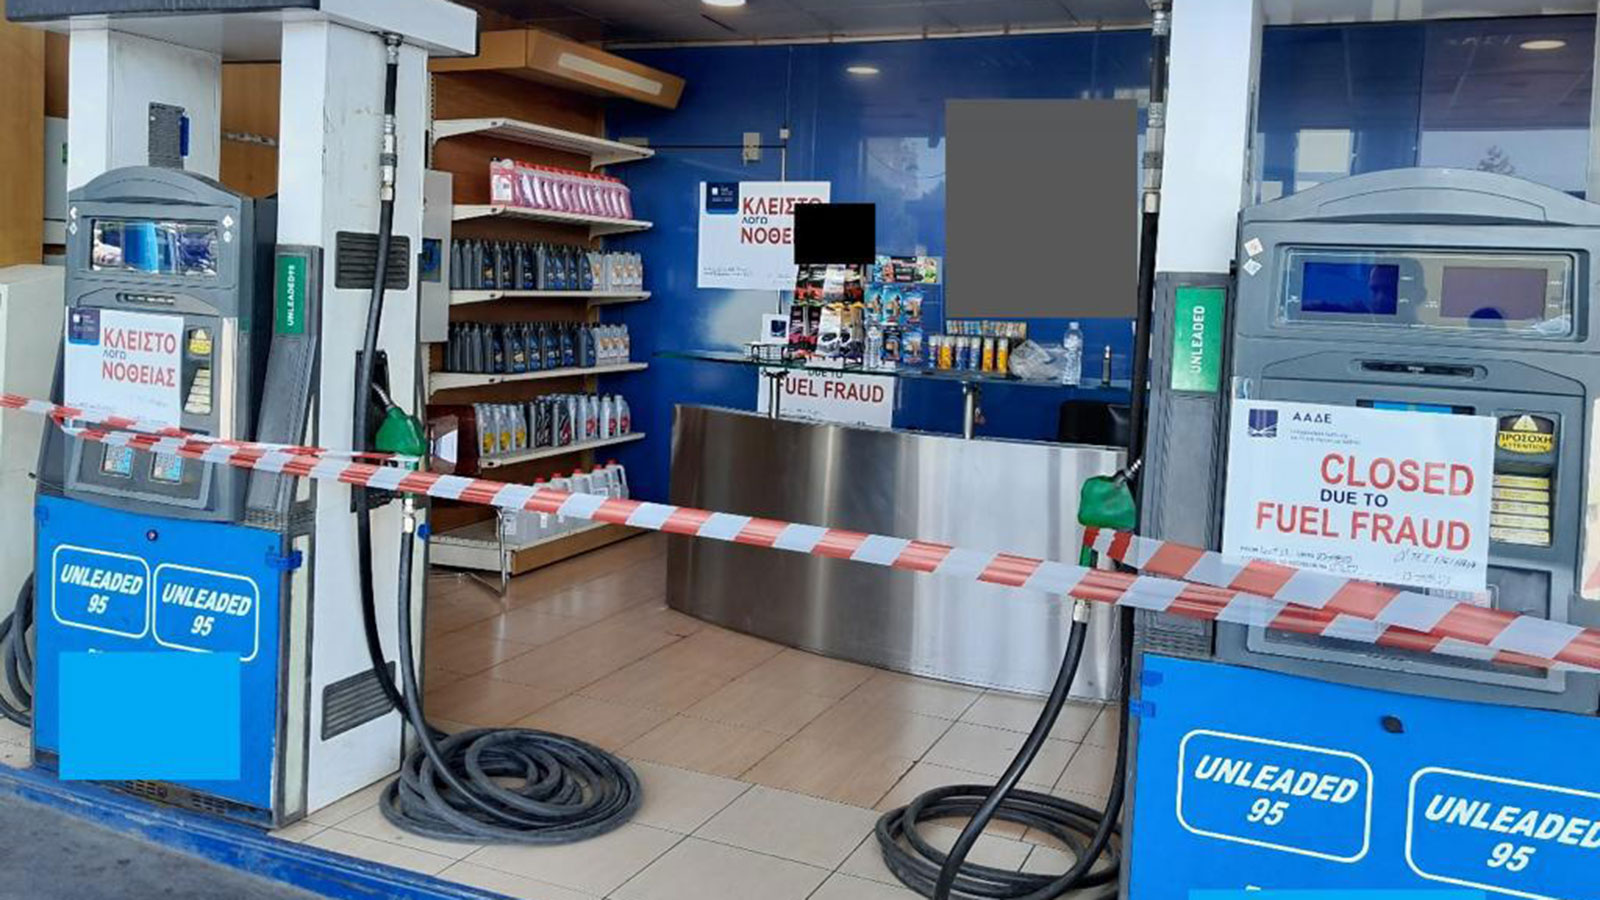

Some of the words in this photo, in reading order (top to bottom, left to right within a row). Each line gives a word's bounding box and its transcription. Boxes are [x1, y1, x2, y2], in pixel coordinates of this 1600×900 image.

[743, 197, 822, 215] ΚΛΕΙΣ
[741, 227, 793, 244] ΝΟΘΕ
[103, 327, 177, 354] ΚΛΕΙΣΤΟ
[1189, 305, 1205, 373] UNLEADED
[102, 349, 127, 360] ΛΟΓΩ
[102, 361, 176, 387] ΝΟΘΕΙΑΣ
[824, 380, 885, 403] FRAUD
[1320, 452, 1475, 497] CLOSED
[1320, 488, 1357, 506] DUE
[1364, 493, 1389, 508] TO
[1255, 501, 1340, 538] FUEL
[1350, 510, 1471, 552] FRAUD
[60, 564, 144, 596] UNLEADED
[87, 594, 110, 614] 95
[161, 583, 253, 617] UNLEADED
[190, 615, 215, 637] 95
[1193, 755, 1360, 805] UNLEADED
[1246, 798, 1290, 827] 95
[1486, 842, 1537, 873] 95
